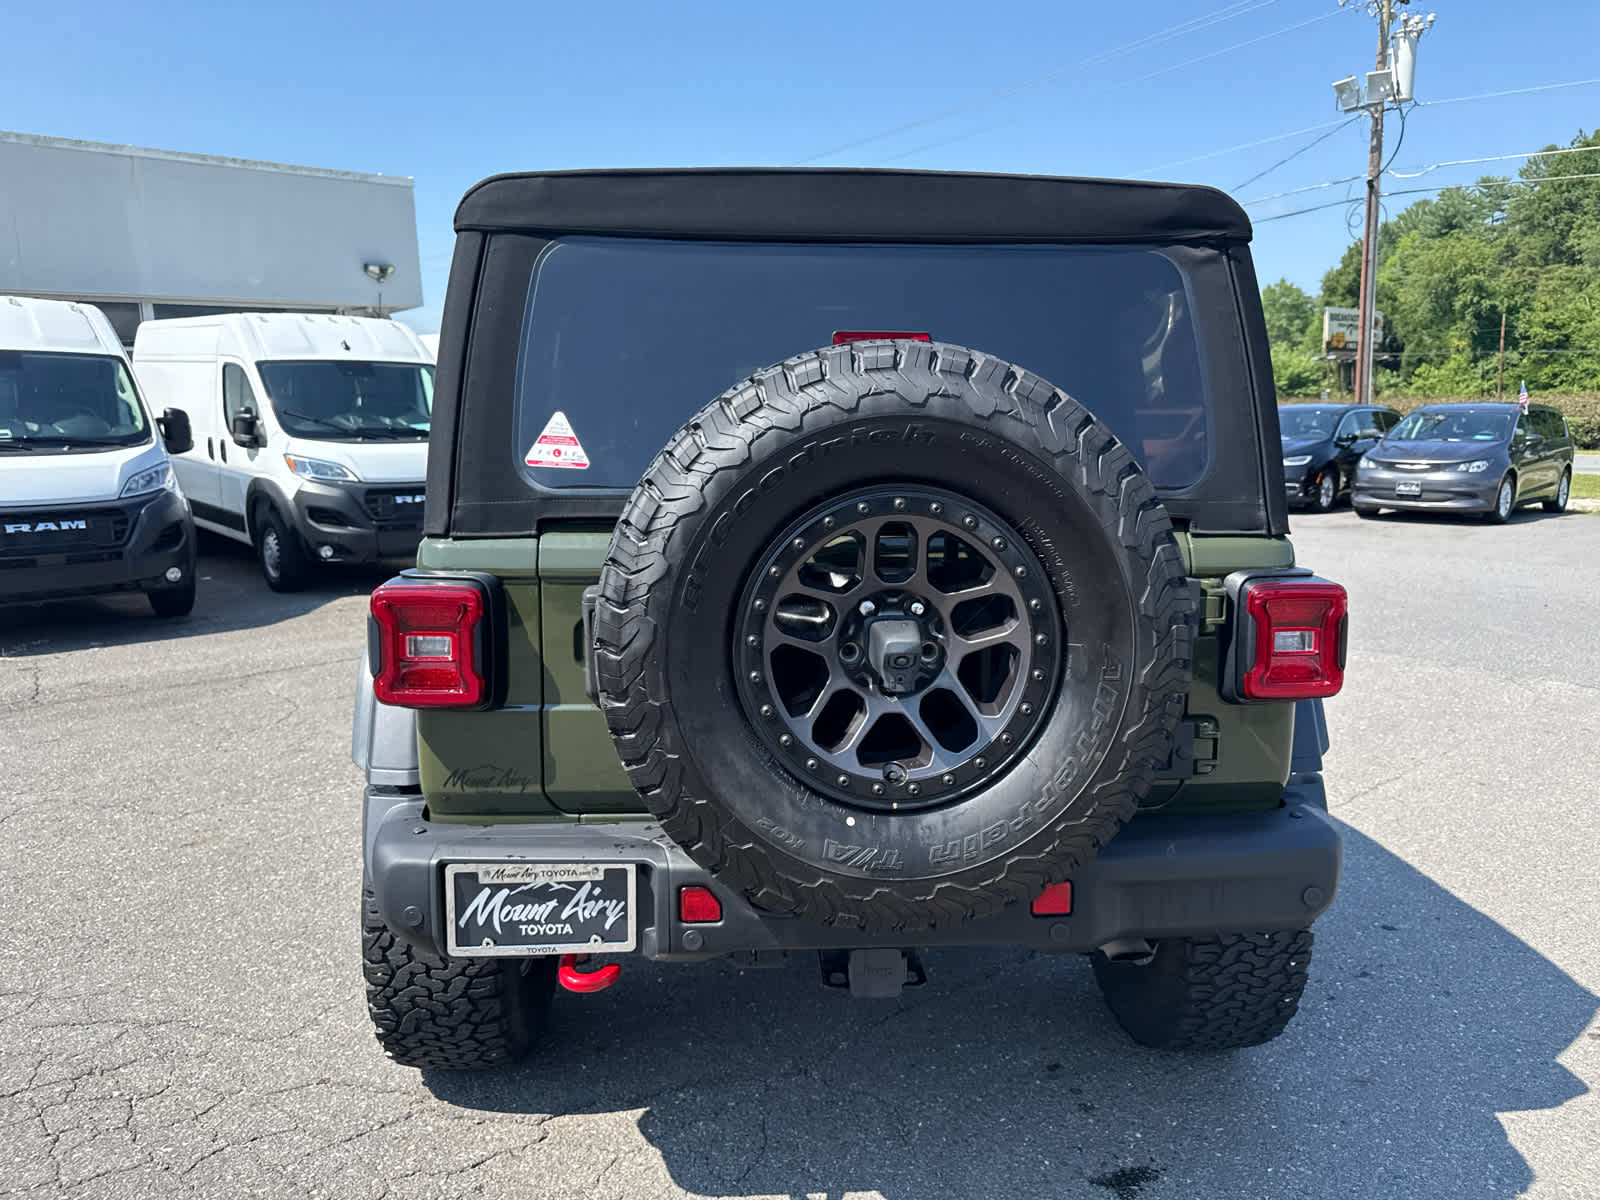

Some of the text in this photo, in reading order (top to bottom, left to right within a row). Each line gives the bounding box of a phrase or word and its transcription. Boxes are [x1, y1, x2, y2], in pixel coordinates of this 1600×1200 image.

[4, 520, 87, 534] RAM
[443, 766, 529, 792] Mount Airy
[491, 868, 520, 880] Mount
[520, 866, 538, 880] Airy
[541, 869, 578, 878] TOYOTA
[458, 880, 626, 935] Mount Airy
[518, 923, 574, 936] TOYOTA
[526, 946, 558, 954] TOYOTA
